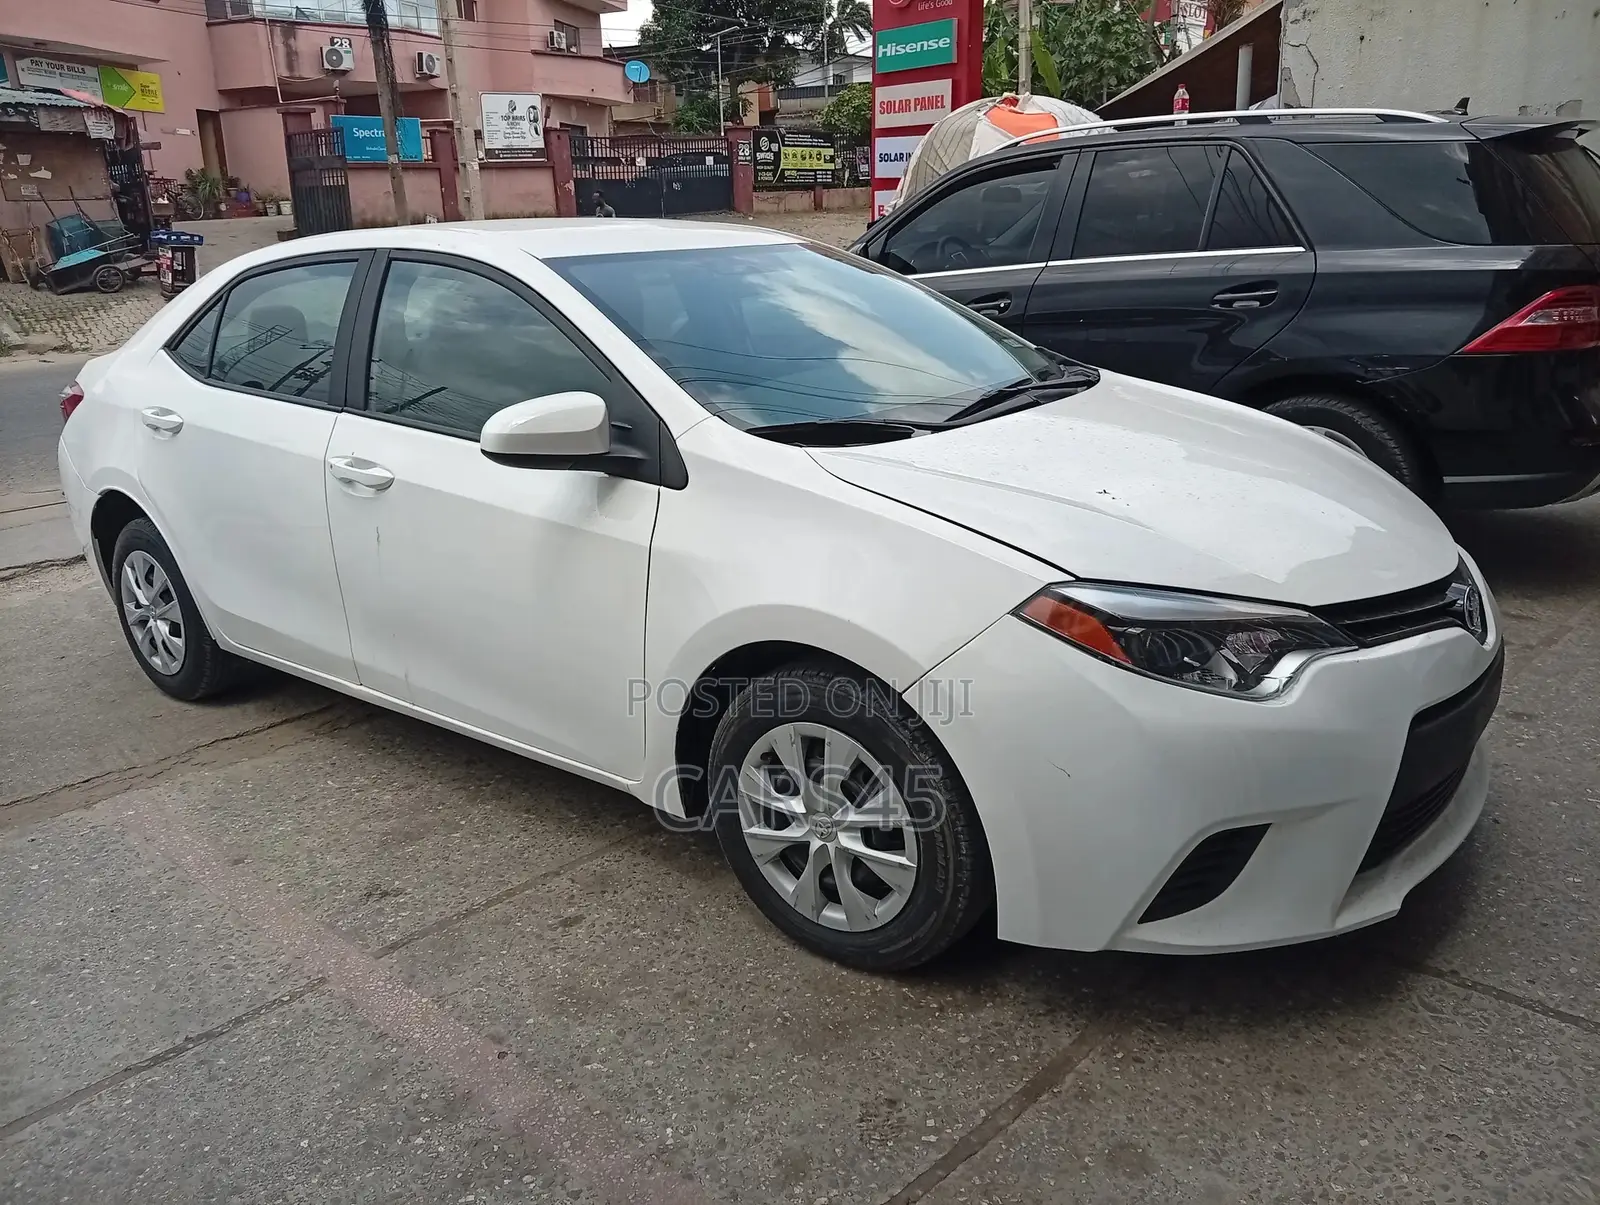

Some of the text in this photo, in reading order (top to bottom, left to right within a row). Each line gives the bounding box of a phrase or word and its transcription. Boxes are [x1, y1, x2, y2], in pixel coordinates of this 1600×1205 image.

[333, 38, 350, 48] 28
[878, 37, 951, 58] Hisense
[30, 59, 44, 68] PAY
[45, 61, 65, 71] YOUR
[66, 65, 86, 74] BILLS
[879, 95, 946, 115] SOLAR PANEL
[353, 127, 386, 139] Spectra
[739, 143, 750, 156] 28
[878, 152, 905, 163] SOLAR
